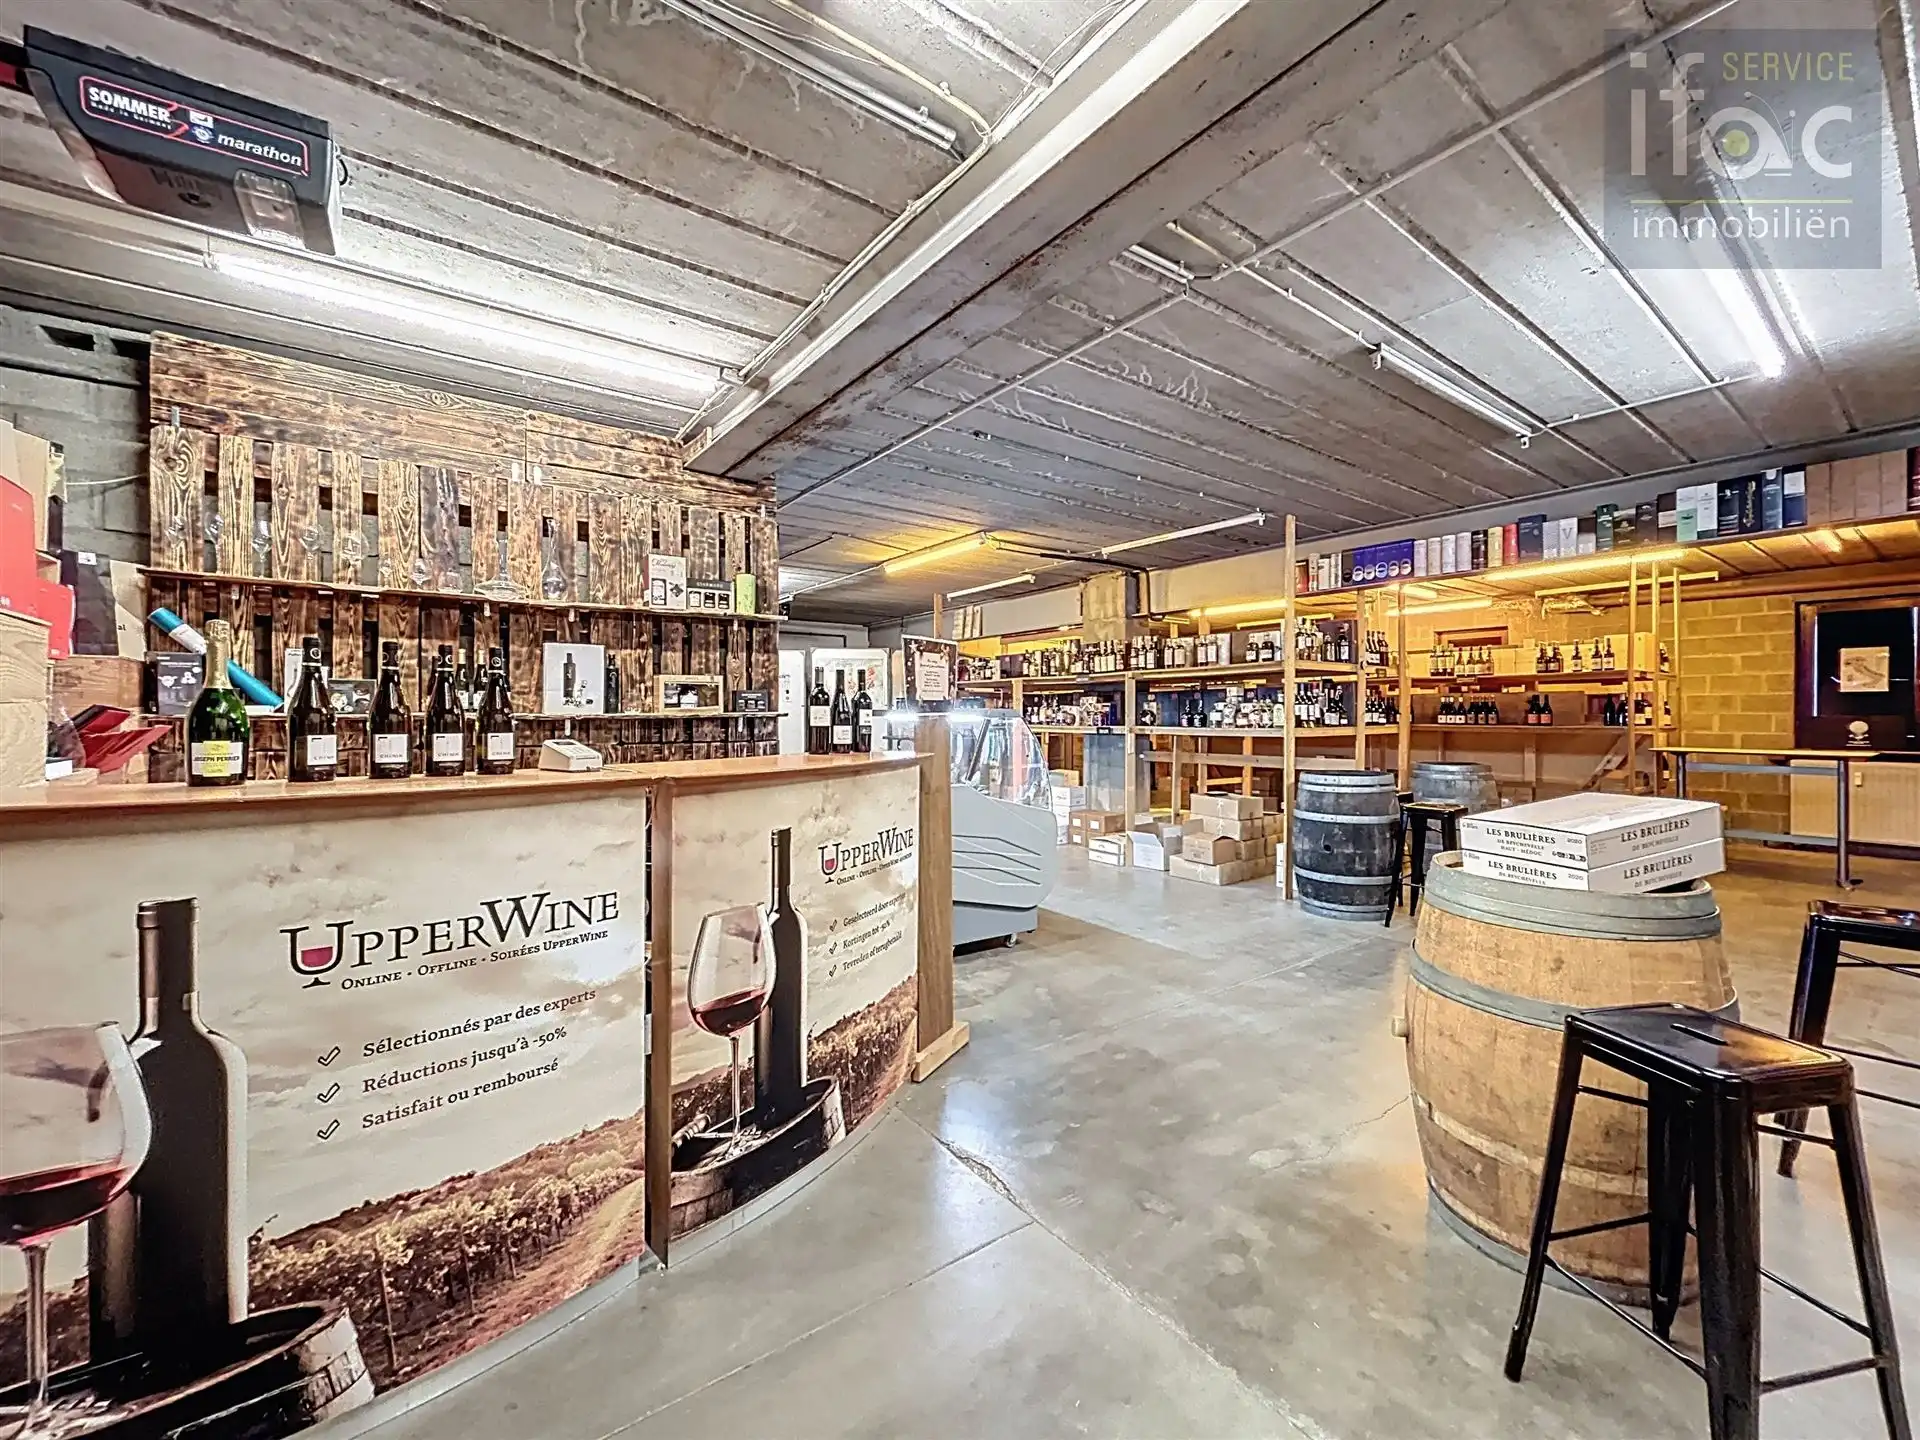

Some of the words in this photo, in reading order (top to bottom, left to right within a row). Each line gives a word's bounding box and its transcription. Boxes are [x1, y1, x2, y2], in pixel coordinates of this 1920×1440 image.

[88, 86, 171, 122] SOMMER
[217, 132, 302, 167] marathon
[1486, 828, 1502, 836] LES
[1504, 830, 1556, 844] BRULIÈRES
[1621, 830, 1638, 843] LES
[1640, 818, 1690, 838] BRULIÈRES
[1488, 860, 1503, 870] LES
[1506, 863, 1557, 880] BRULIÈRES
[1623, 866, 1640, 879] LES
[1643, 853, 1693, 875] BRULIÈRES
[842, 930, 872, 950] Kortingen
[842, 952, 870, 972] Tevreden
[363, 1019, 480, 1058] Sélectionnés
[483, 1011, 512, 1036] par
[515, 1004, 541, 1020] des
[543, 989, 597, 1015] experts
[362, 1056, 468, 1093] Réductions
[532, 1026, 567, 1050] -50%
[362, 1095, 443, 1129] Satisfait
[447, 1089, 469, 1104] ou
[473, 1058, 559, 1097] remboursé
